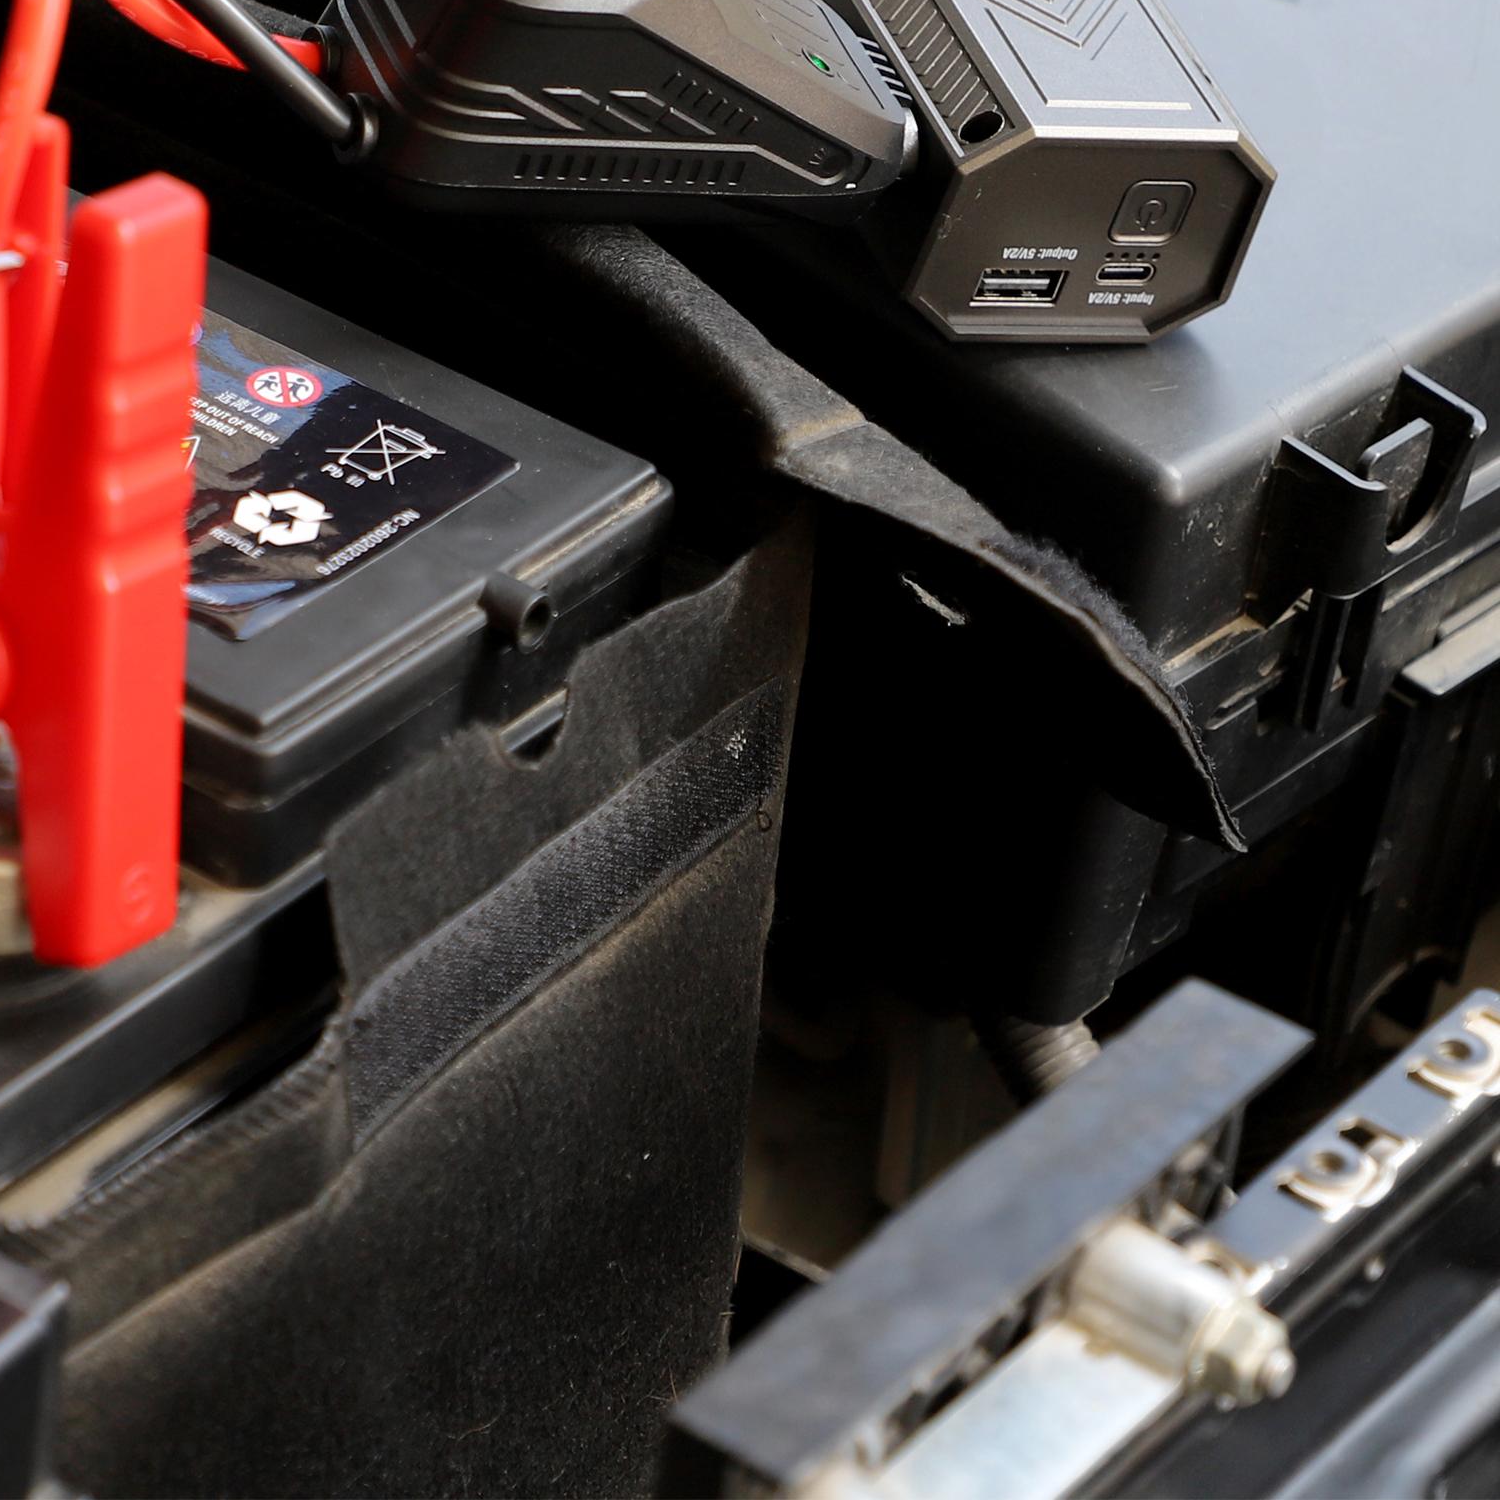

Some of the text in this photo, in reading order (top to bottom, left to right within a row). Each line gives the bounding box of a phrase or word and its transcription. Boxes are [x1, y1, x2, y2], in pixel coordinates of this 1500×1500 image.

[1002, 245, 1078, 261] Output: 5V/2A
[1088, 292, 1155, 306] Input: 5V/2A
[187, 408, 238, 437] CHILDREN
[214, 390, 282, 426] 远离儿童
[206, 405, 230, 420] OUT
[229, 416, 244, 430] OF
[242, 422, 280, 445] REACH
[320, 462, 344, 479] Pb
[209, 525, 265, 560] RECYCLE
